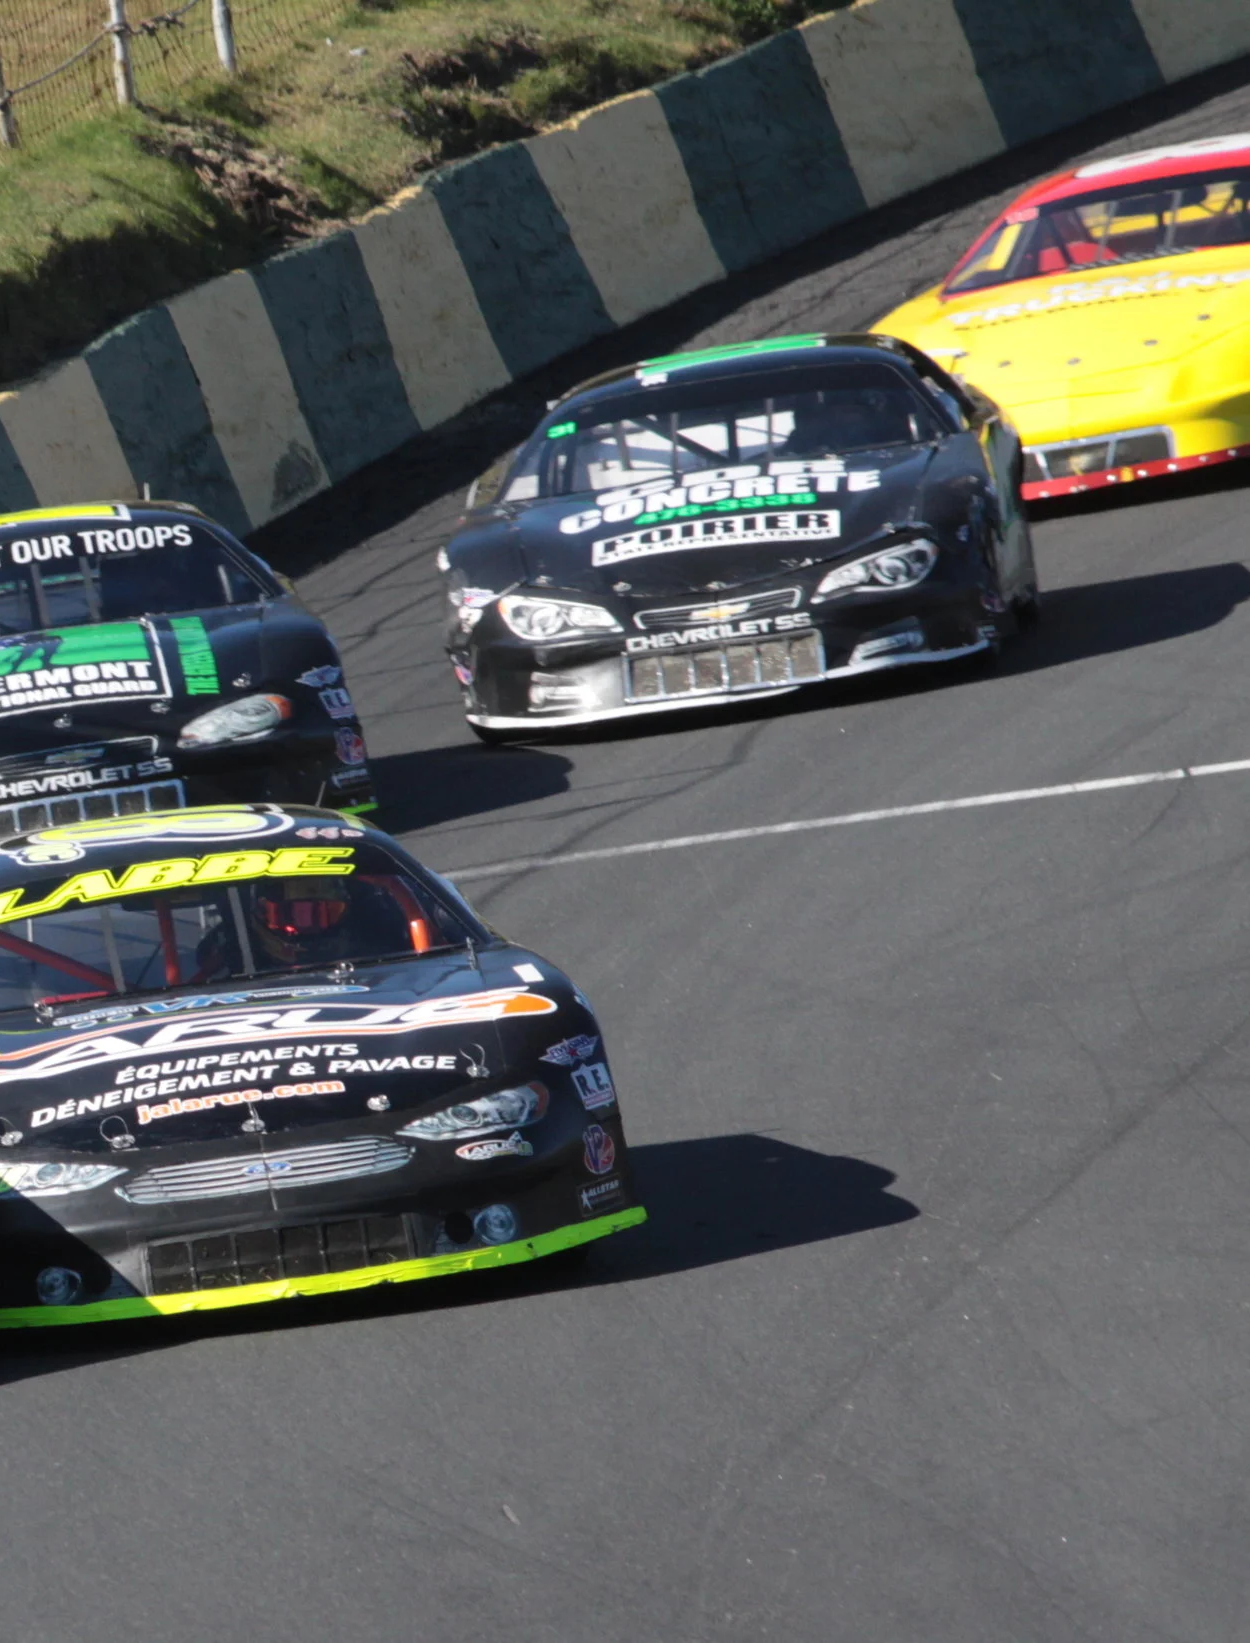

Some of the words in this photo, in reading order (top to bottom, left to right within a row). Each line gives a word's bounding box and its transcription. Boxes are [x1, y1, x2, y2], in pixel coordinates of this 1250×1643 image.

[558, 469, 881, 534] CONCRETE
[10, 534, 74, 565] OUR
[77, 524, 194, 555] TROOPS
[626, 617, 770, 653] CHEVROLET
[774, 612, 812, 633] SS
[72, 680, 158, 698] GUARD
[136, 756, 173, 778] SS
[115, 1043, 359, 1086] ÉQUIPEMENTS
[30, 1064, 280, 1128] DÉNEIGEMENT
[289, 1060, 316, 1077] &
[328, 1054, 456, 1074] PAVAGE
[136, 1080, 346, 1126] jalarue.com
